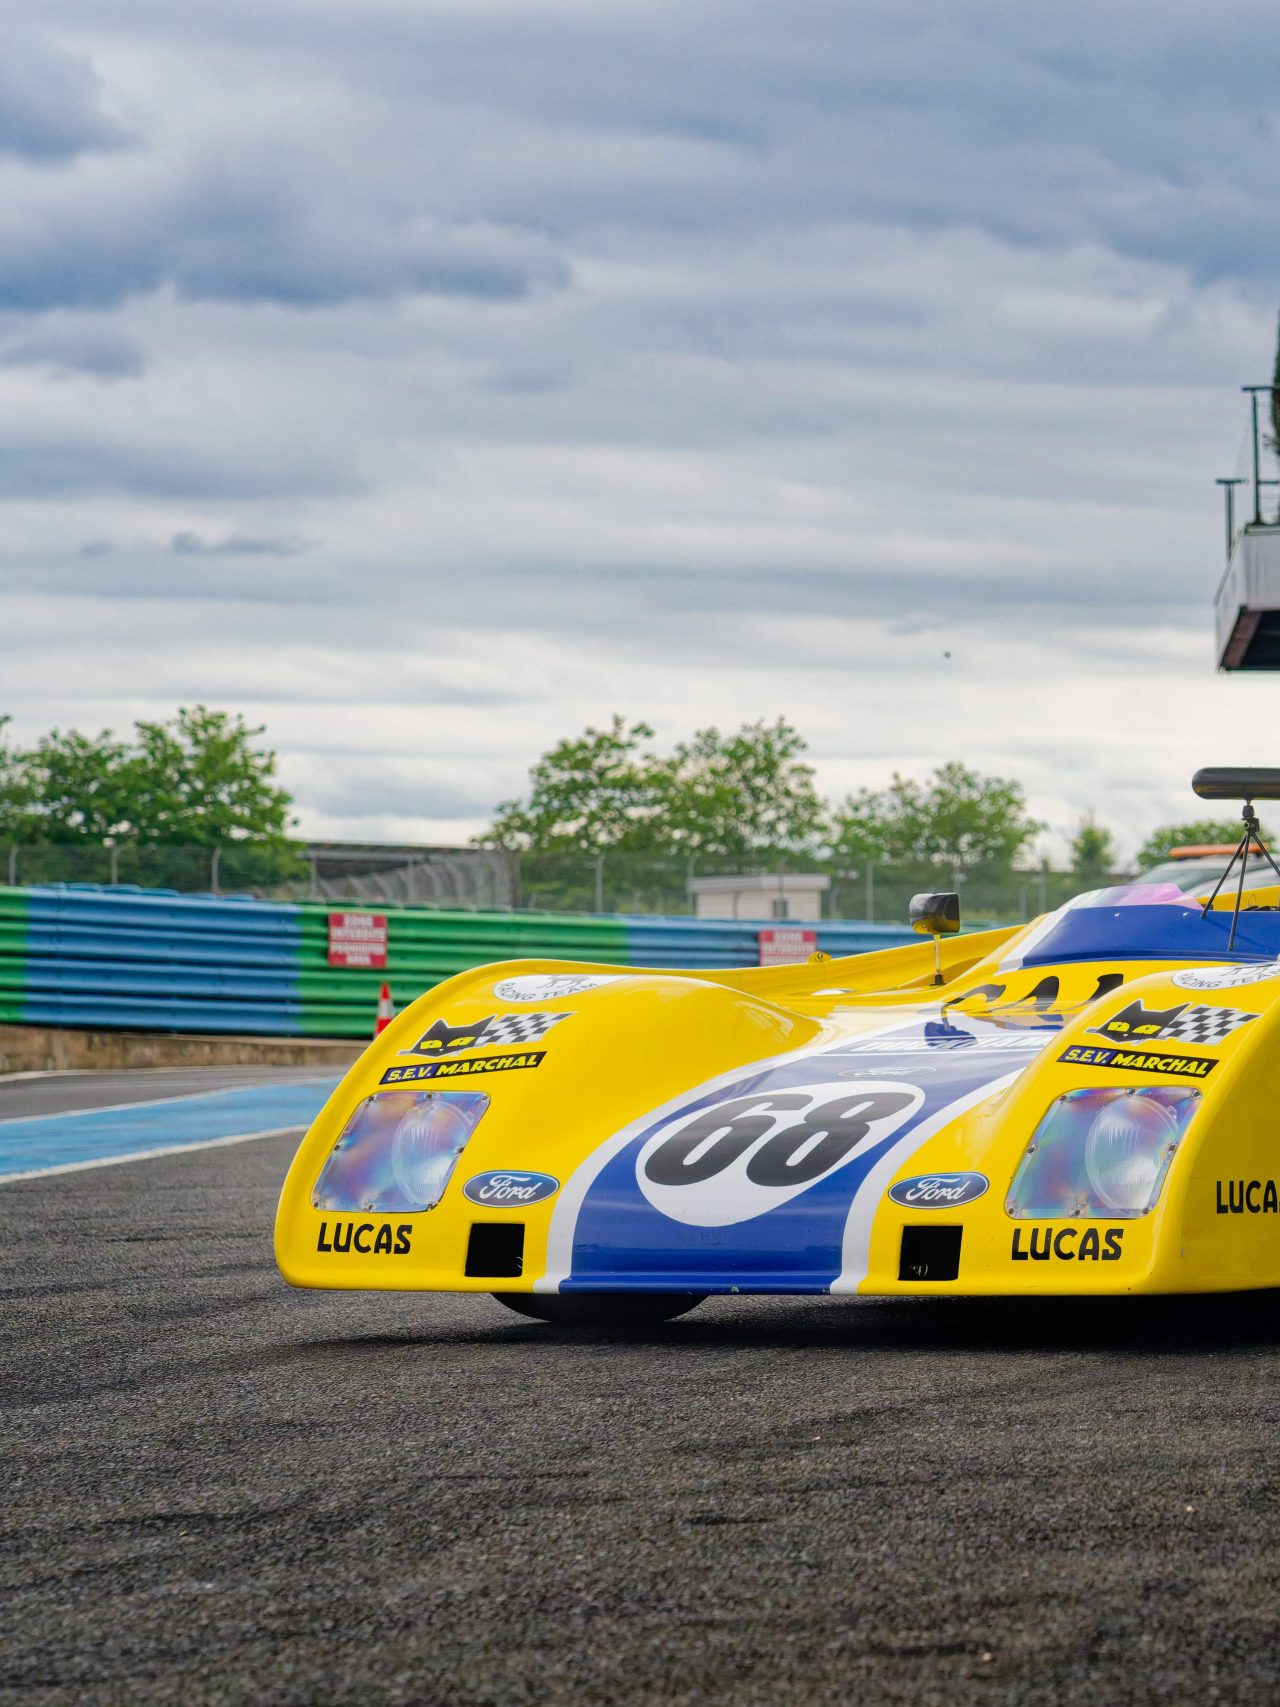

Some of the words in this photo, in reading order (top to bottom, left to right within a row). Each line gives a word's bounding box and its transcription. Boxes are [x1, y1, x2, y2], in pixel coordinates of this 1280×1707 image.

[387, 1066, 432, 1082] S.E.V.
[435, 1054, 538, 1076] MARCHAL
[1065, 1049, 1111, 1064] S.E.V.
[1110, 1053, 1211, 1075] MARCHAL
[644, 1092, 916, 1188] 68
[479, 1174, 543, 1200] Ford
[904, 1177, 971, 1201] Ford
[317, 1221, 413, 1255] LUCAS
[1011, 1227, 1124, 1261] LUCAS
